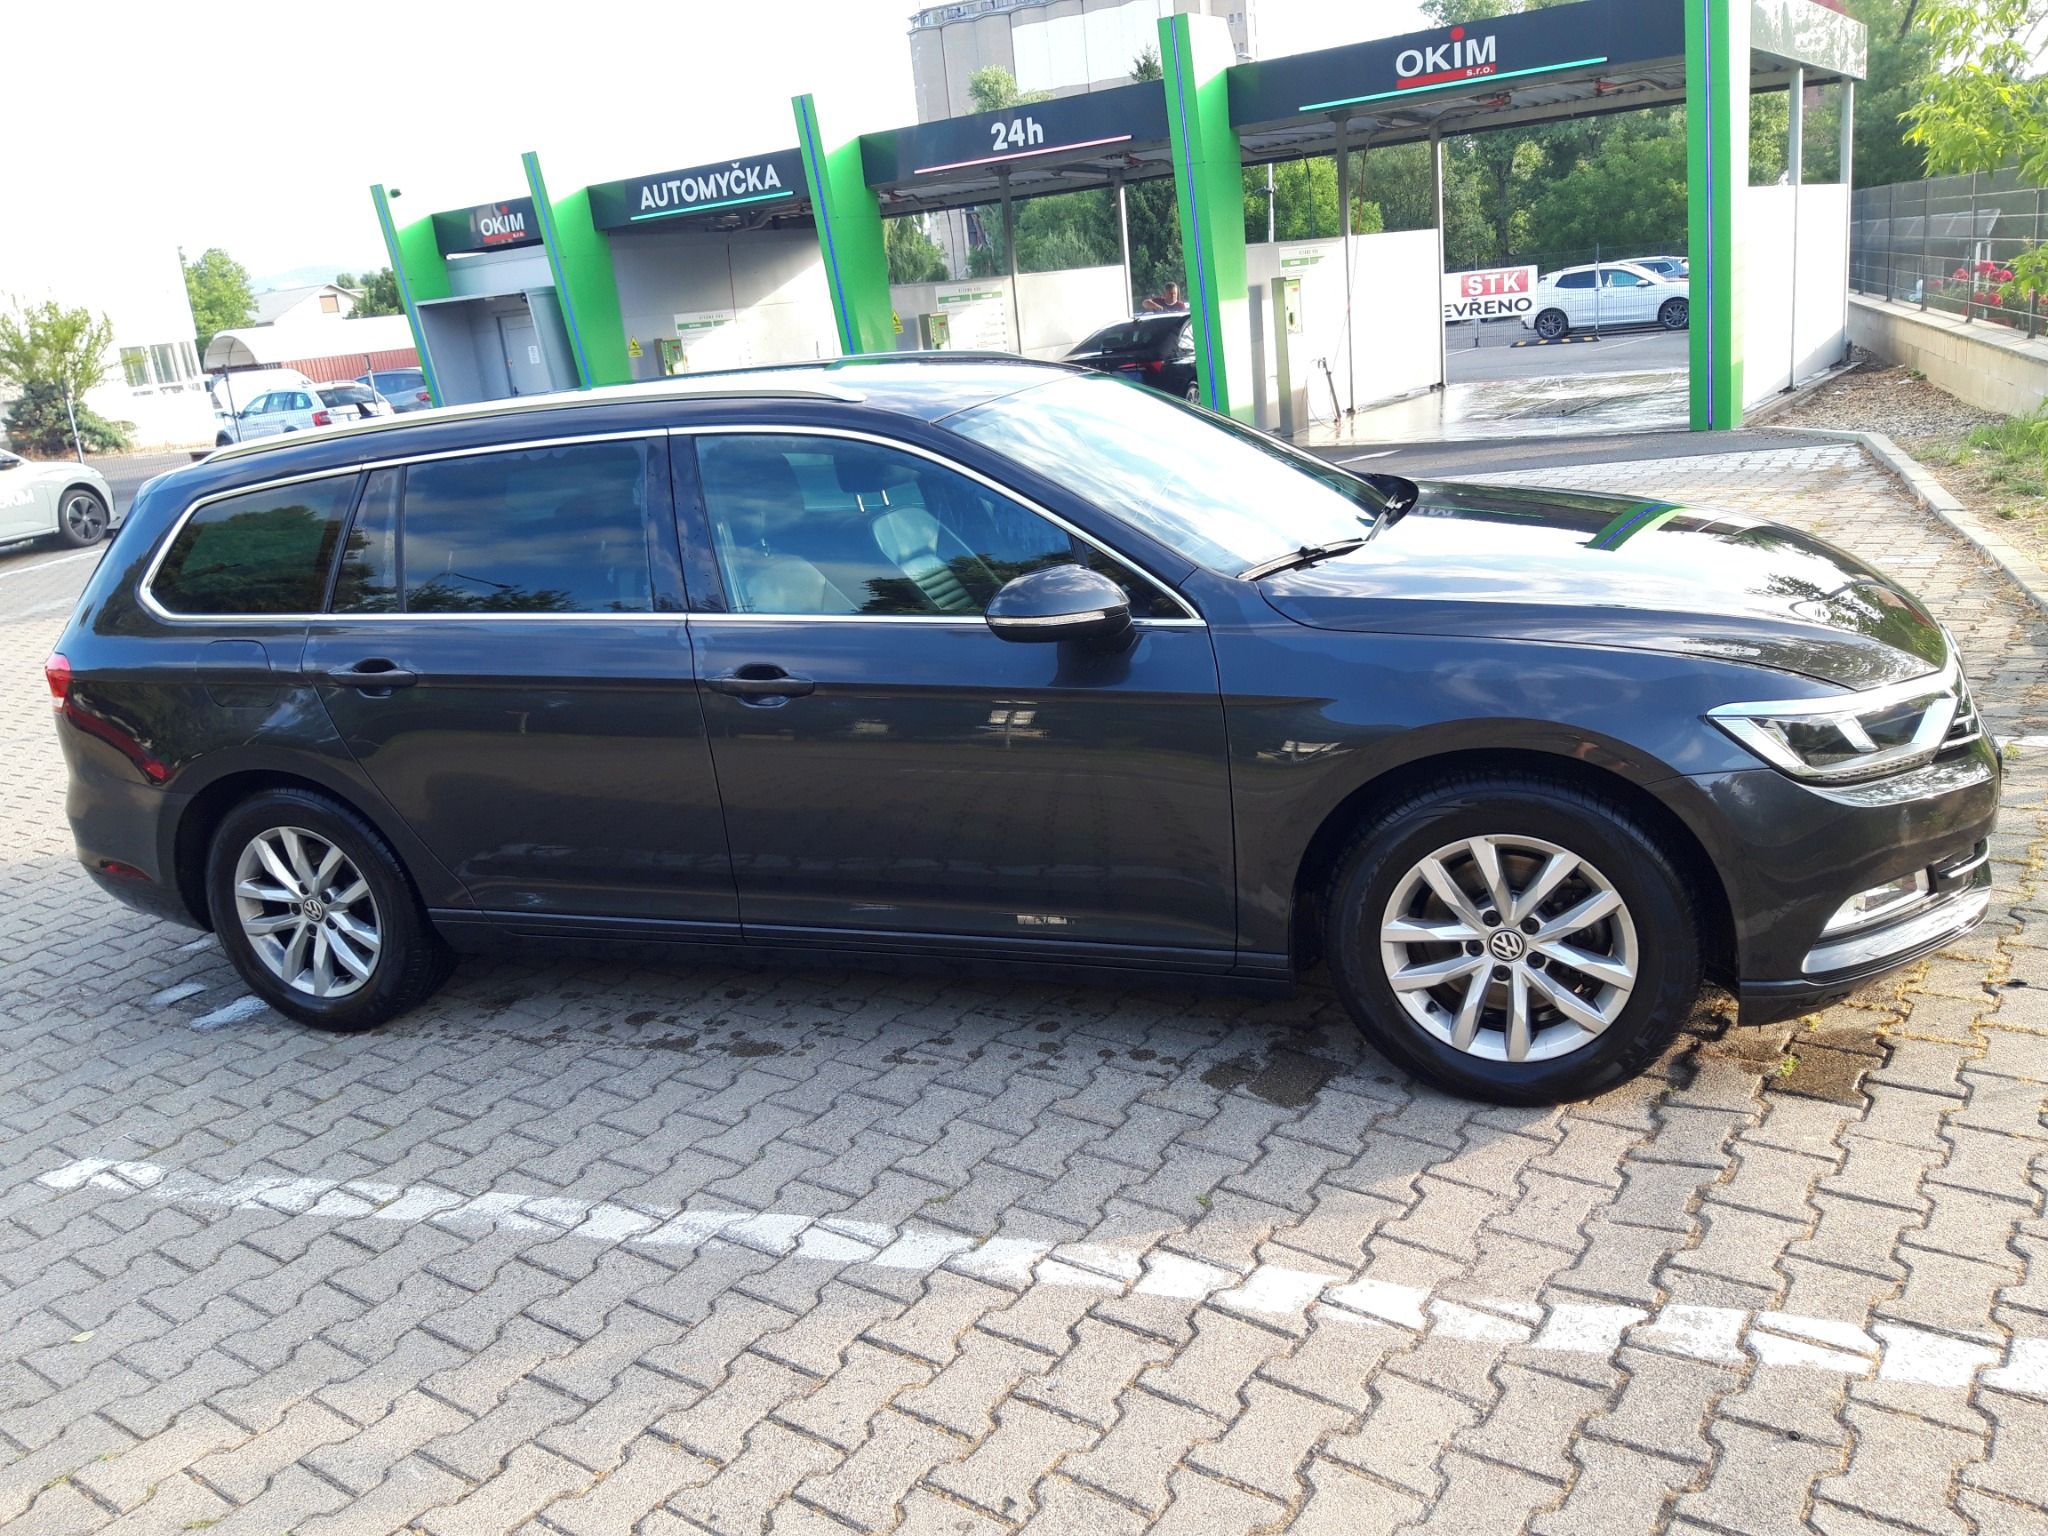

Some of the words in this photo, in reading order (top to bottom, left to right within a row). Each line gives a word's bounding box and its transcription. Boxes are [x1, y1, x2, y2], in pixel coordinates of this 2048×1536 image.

[1466, 66, 1494, 77] s.r.o.
[990, 116, 1044, 151] 24h
[640, 162, 782, 210] AUTOMYČKA
[1467, 271, 1520, 296] STK
